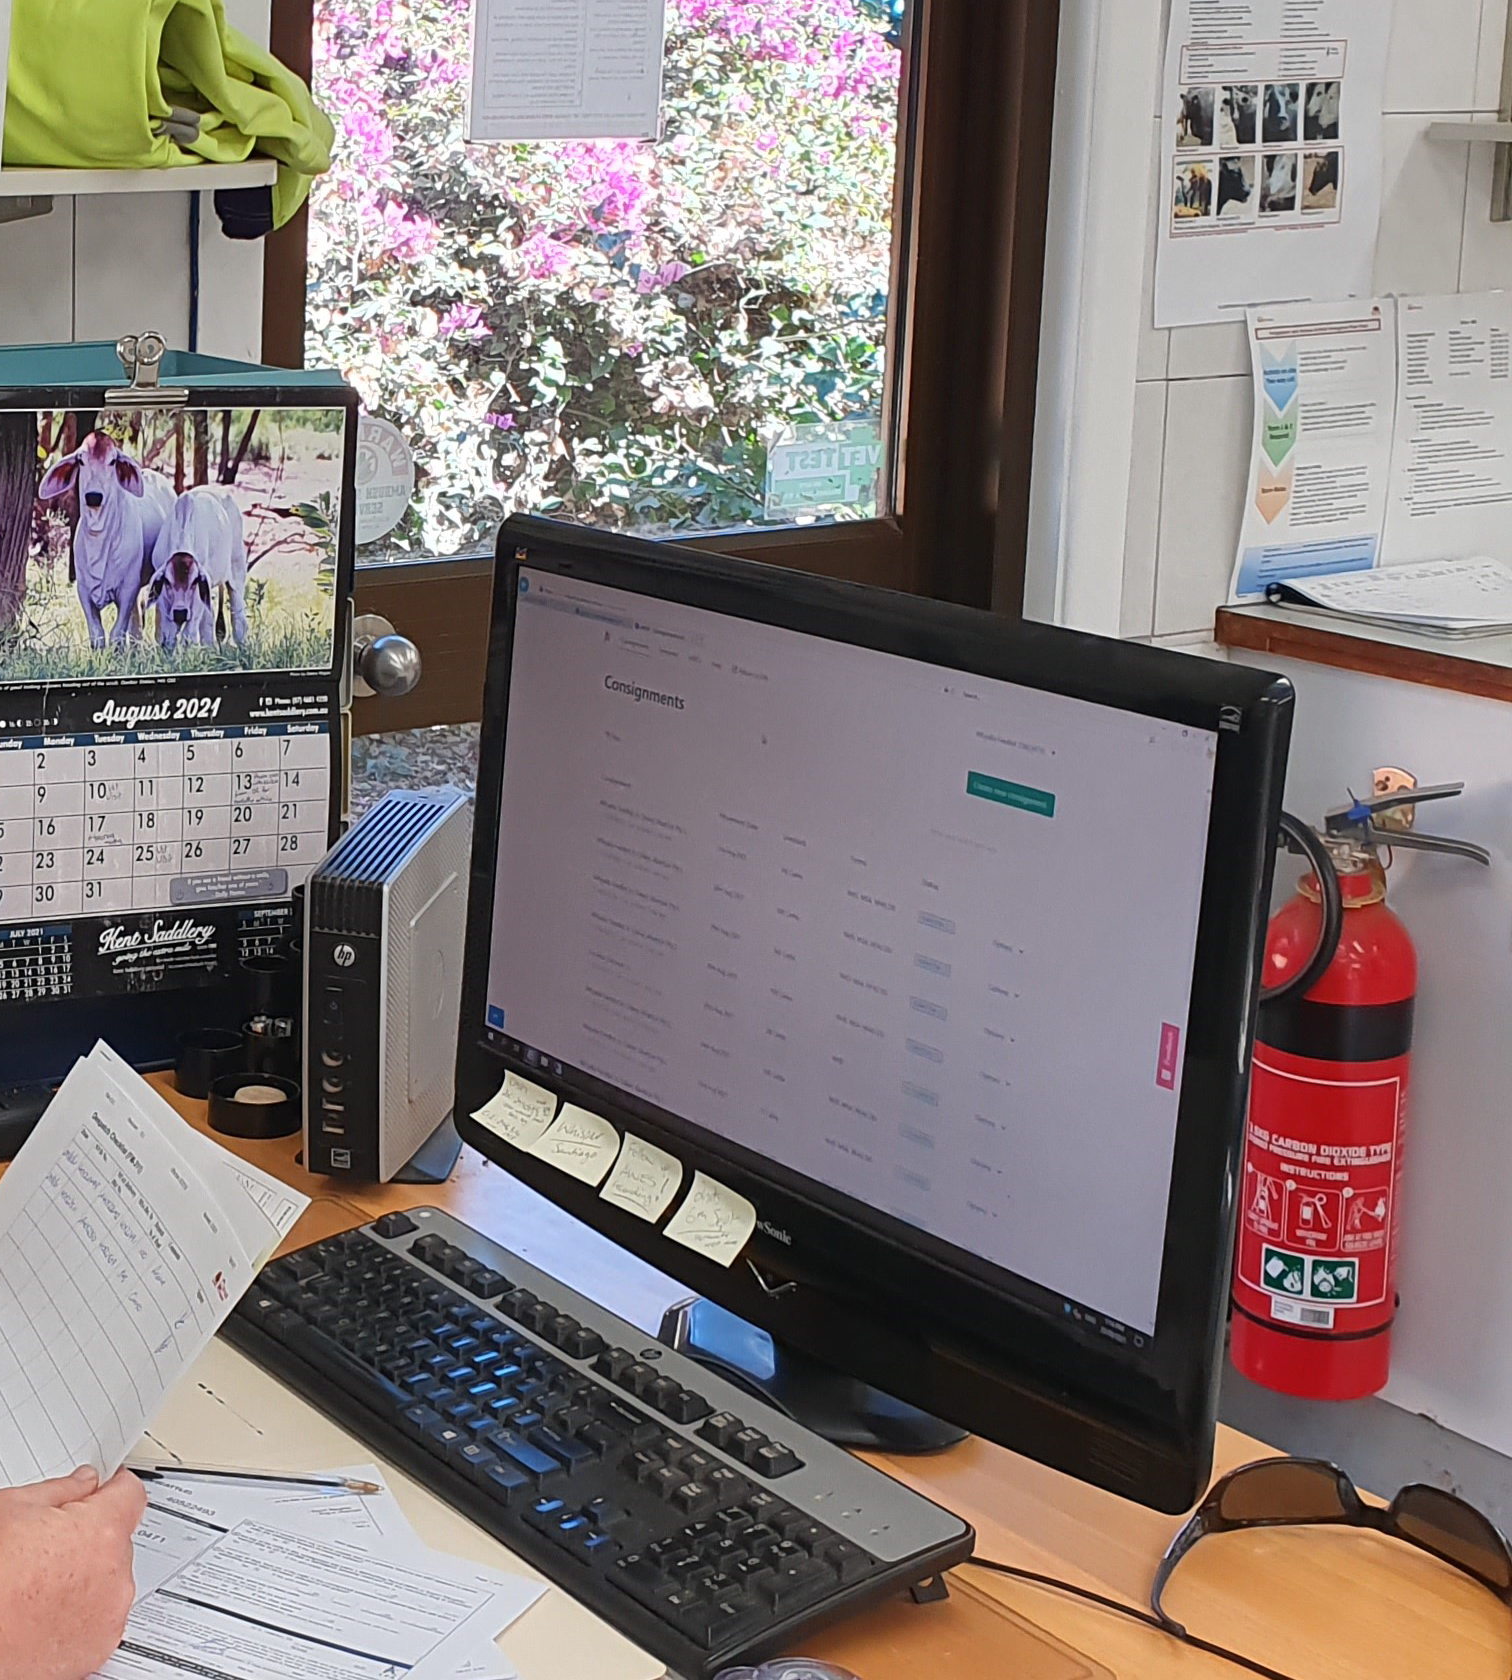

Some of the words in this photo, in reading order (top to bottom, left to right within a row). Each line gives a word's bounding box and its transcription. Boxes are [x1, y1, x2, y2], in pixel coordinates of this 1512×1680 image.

[604, 673, 686, 711] Consignments
[92, 699, 171, 730] August
[173, 696, 223, 720] 2021
[43, 735, 75, 747] Monday
[94, 732, 125, 744] Tuesday
[137, 730, 181, 742] Wednesday
[190, 728, 225, 739] Thursday
[243, 726, 268, 737] Friday
[287, 723, 320, 734] Saturday
[37, 752, 46, 769] 2
[87, 749, 97, 767] 3
[137, 747, 146, 763] 4
[186, 744, 195, 761] 5
[235, 741, 243, 758] 6
[282, 739, 291, 756] 7
[37, 786, 47, 803] 9
[89, 782, 107, 800] 10
[138, 779, 154, 796] 11
[187, 776, 204, 793] 12
[236, 773, 253, 791] 13
[283, 771, 300, 788] 14
[38, 818, 56, 836] 16
[88, 815, 106, 833] 17
[138, 811, 155, 829] 18
[187, 808, 204, 826] 19
[233, 806, 252, 823] 20
[281, 803, 298, 820] 21
[35, 852, 55, 869] 23
[86, 848, 105, 866] 24
[135, 845, 154, 862] 25
[184, 841, 203, 859] 26
[232, 838, 251, 855] 27
[280, 835, 298, 852] 28
[35, 884, 54, 903] 30
[85, 881, 102, 899] 31
[9, 929, 26, 939] JULY
[26, 927, 44, 938] 2021
[98, 926, 141, 952] Kent
[144, 918, 217, 945] Saddlery
[1271, 1133, 1317, 1155] CARBON
[1320, 1144, 1367, 1158] DIOXIDE
